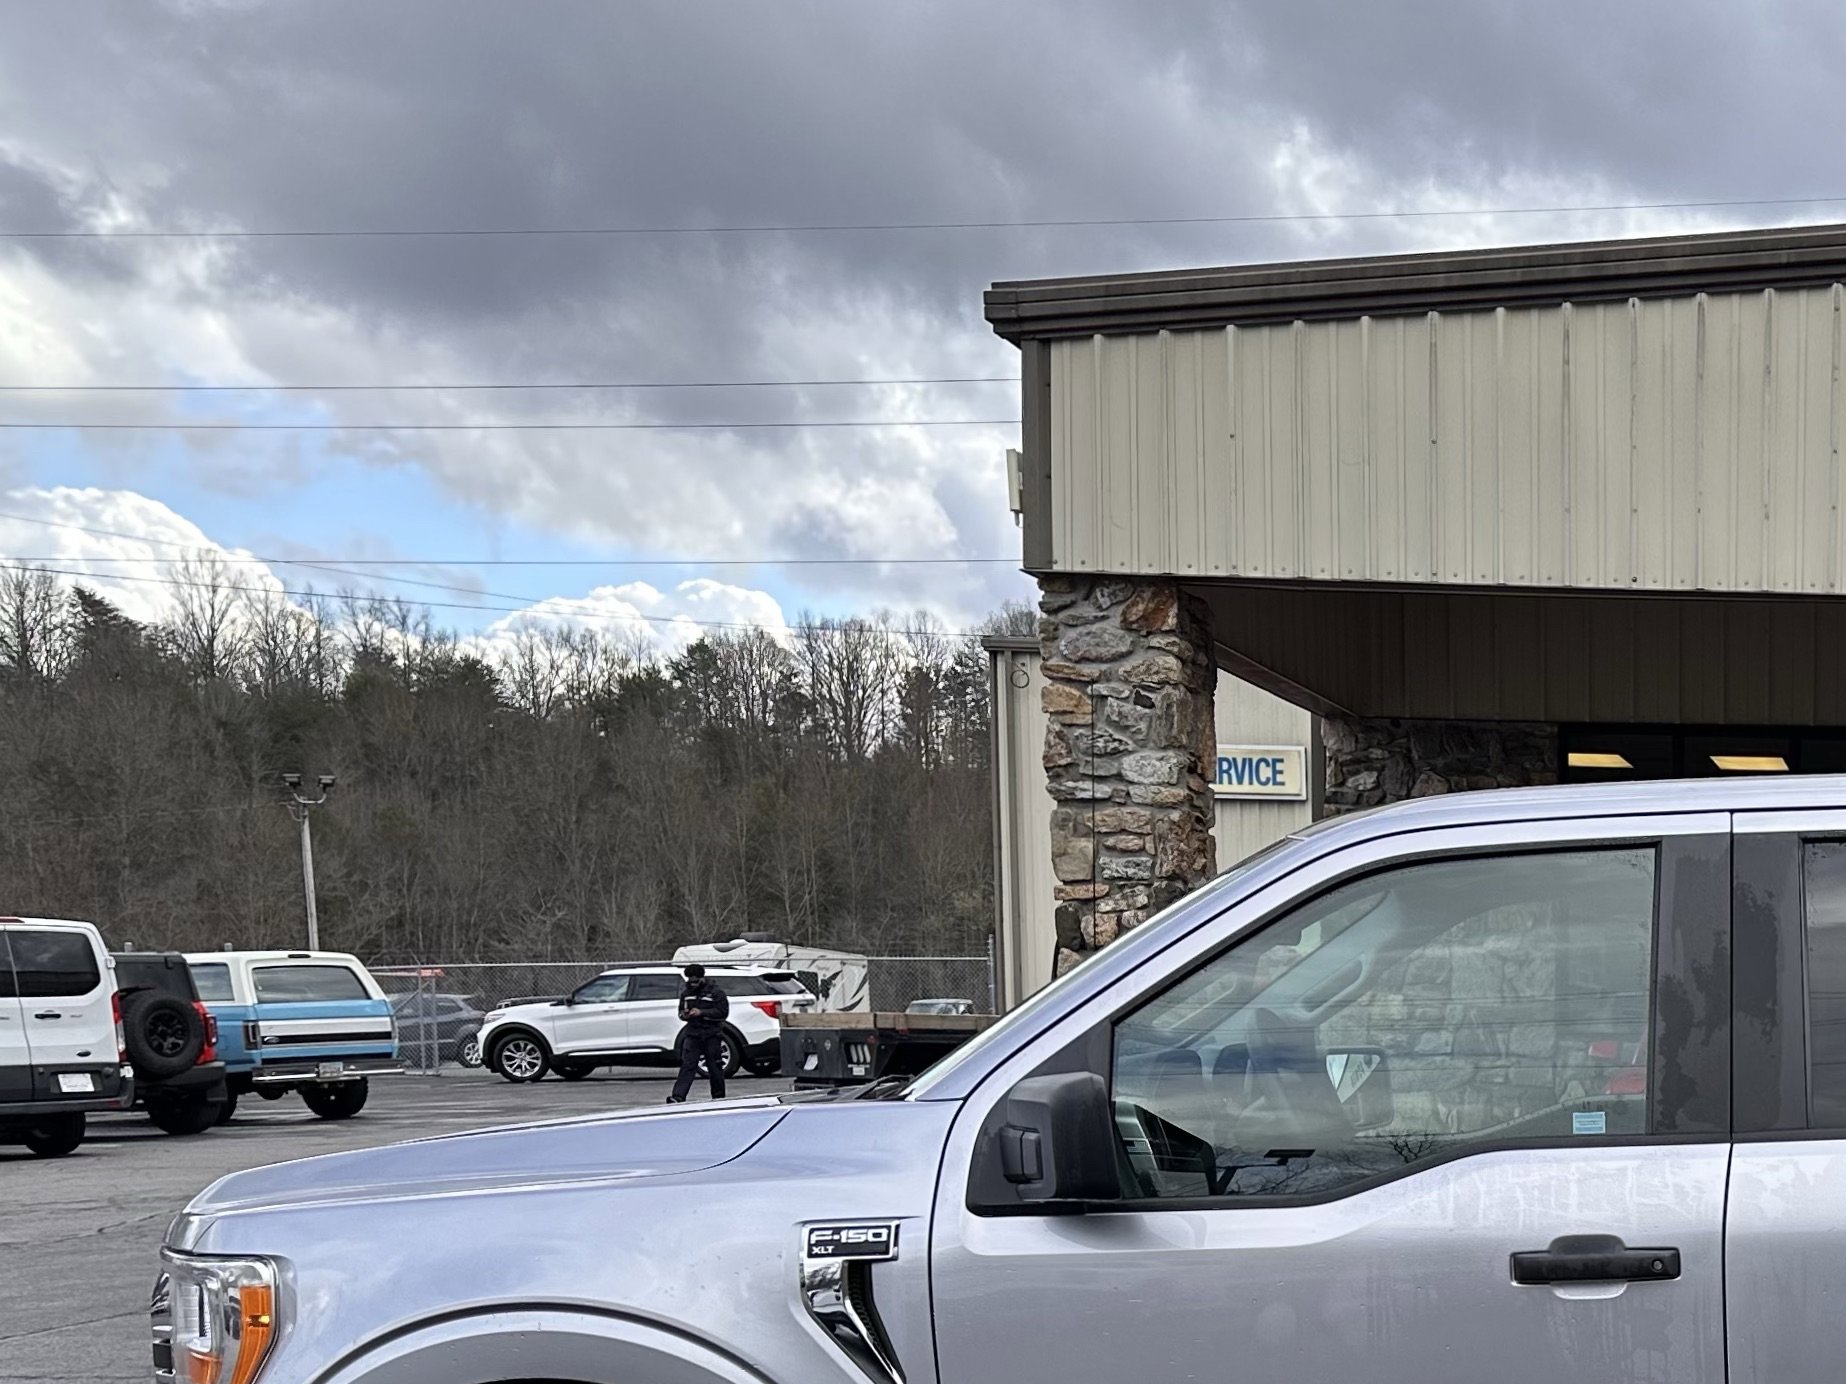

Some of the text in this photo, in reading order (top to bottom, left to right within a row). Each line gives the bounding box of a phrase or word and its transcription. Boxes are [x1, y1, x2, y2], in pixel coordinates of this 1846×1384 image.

[1217, 756, 1286, 786] RVICE
[809, 1228, 889, 1244] F-150
[811, 1245, 835, 1254] XLT
